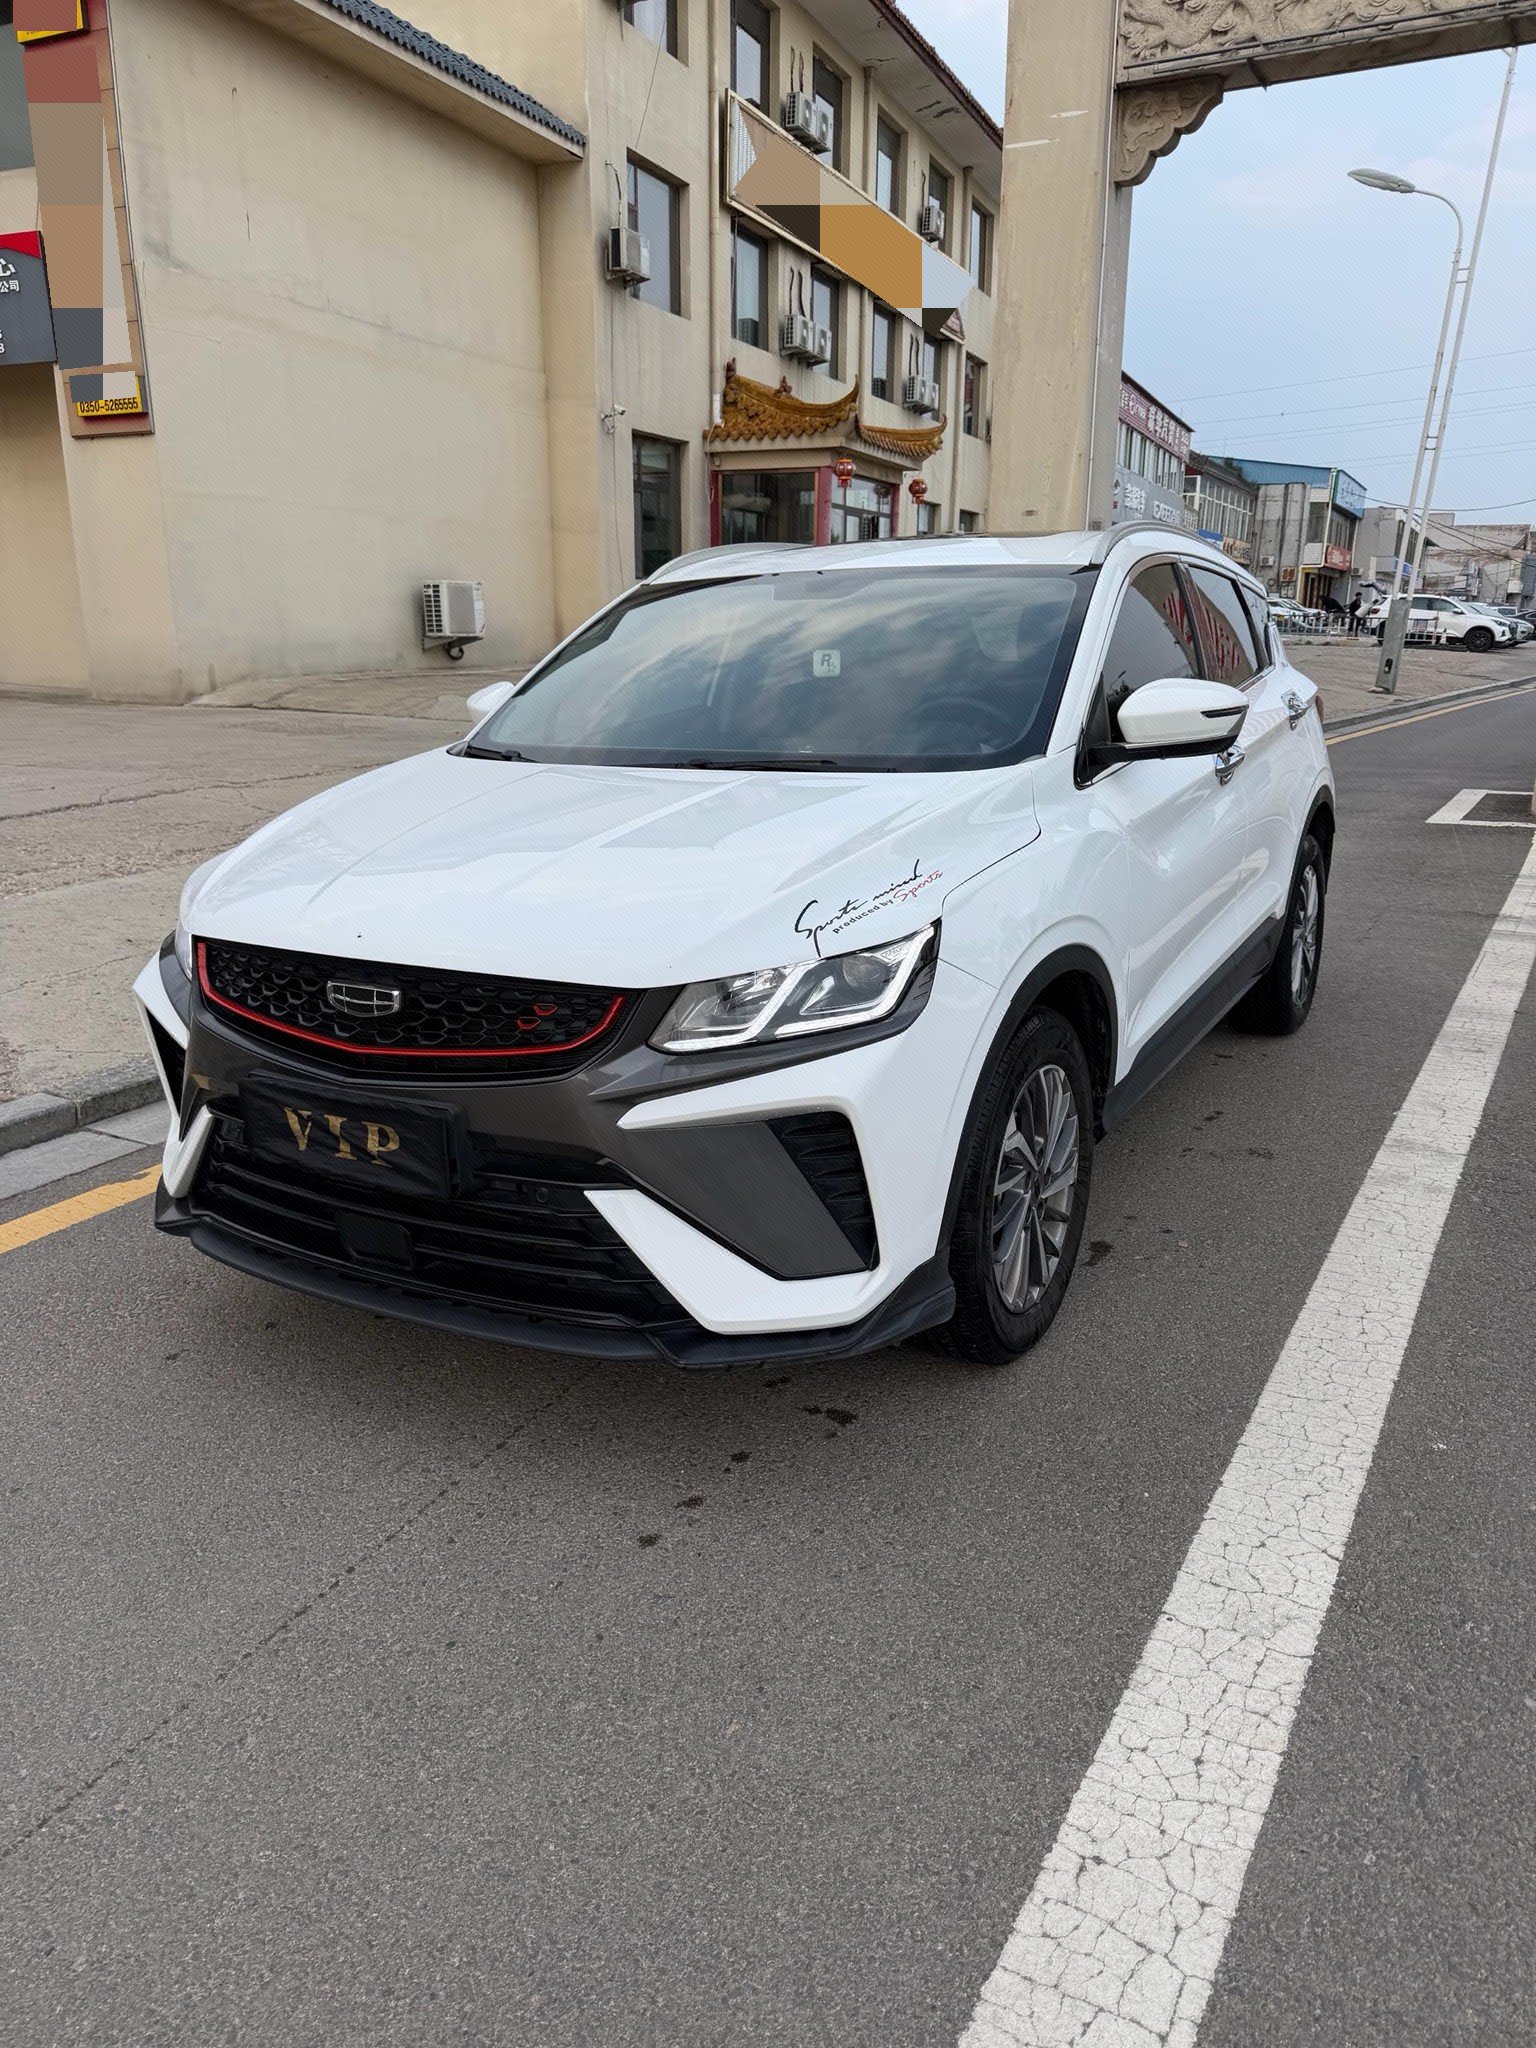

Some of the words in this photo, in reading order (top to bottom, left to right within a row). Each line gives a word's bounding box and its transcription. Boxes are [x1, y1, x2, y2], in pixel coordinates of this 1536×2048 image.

[80, 397, 139, 413] 0350-5265555
[794, 899, 869, 958] Sports
[832, 904, 880, 934] produced
[879, 898, 894, 908] by
[893, 869, 944, 902] Sports
[283, 1106, 401, 1168] VIP
